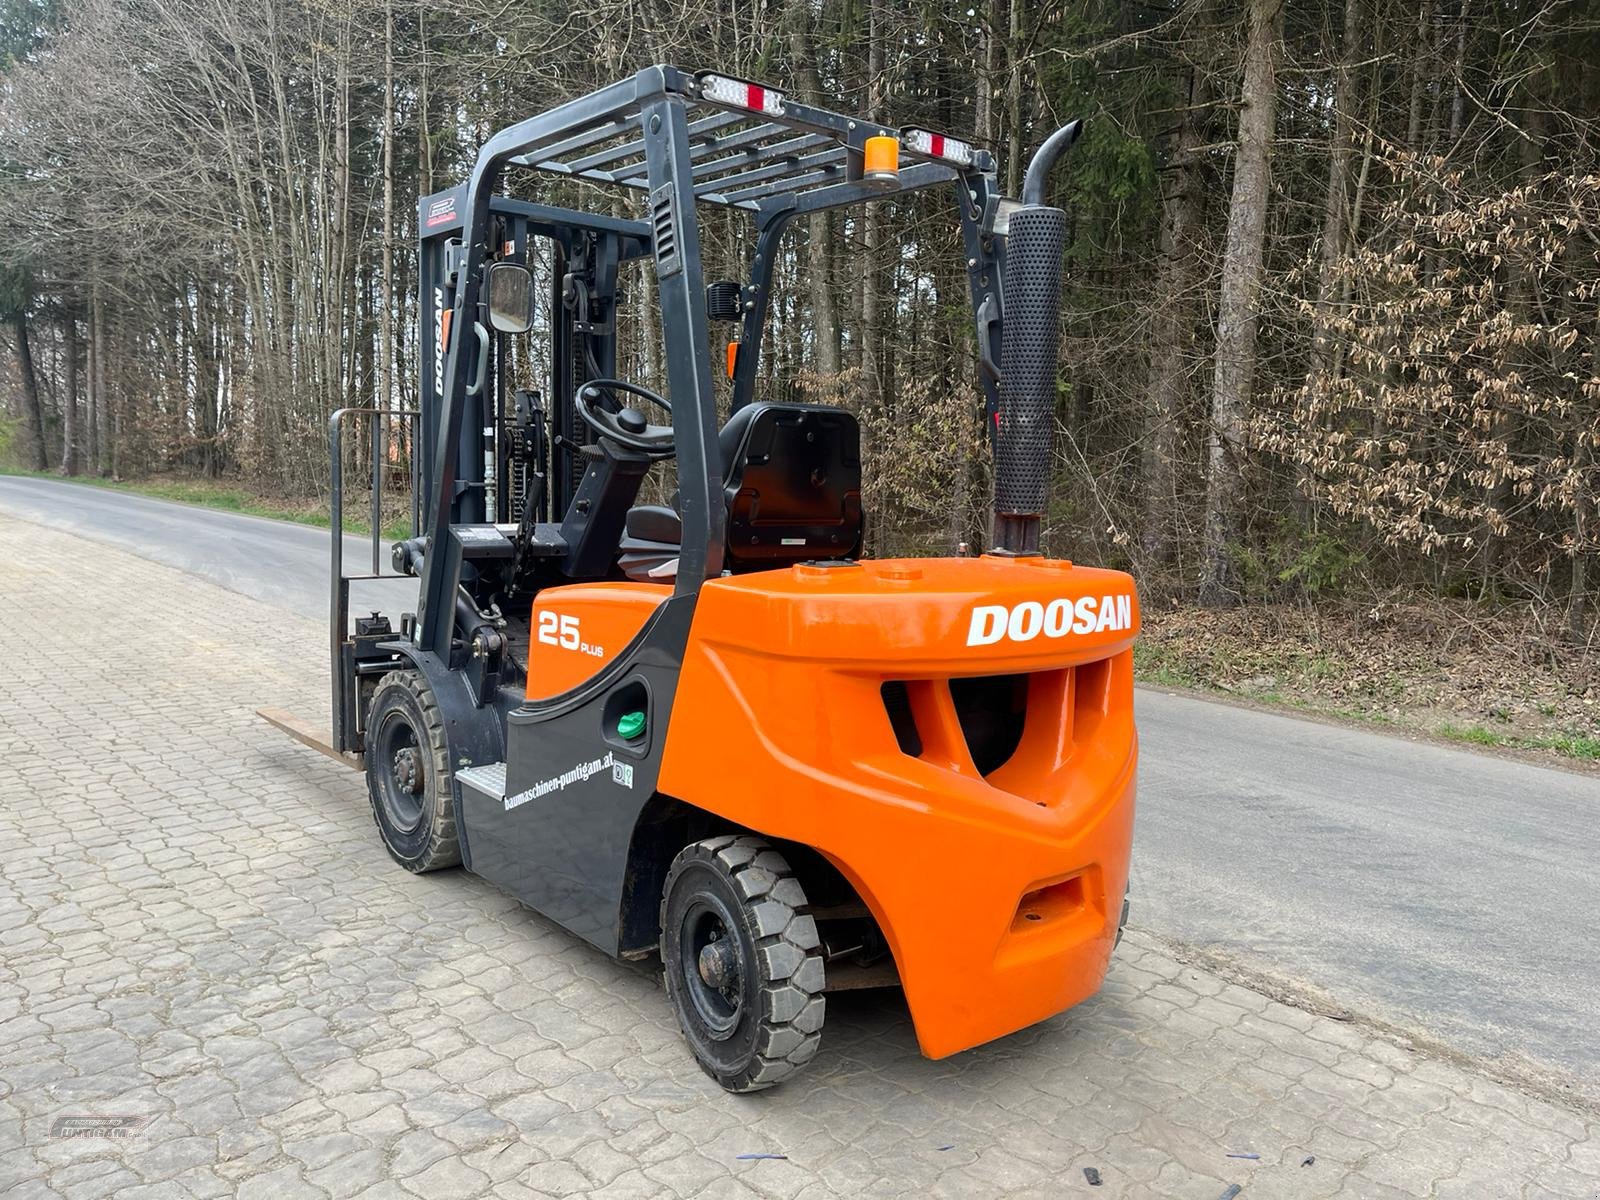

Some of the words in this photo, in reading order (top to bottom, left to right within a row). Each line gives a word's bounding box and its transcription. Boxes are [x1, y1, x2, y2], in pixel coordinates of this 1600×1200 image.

[435, 287, 443, 396] DOOSAN
[538, 610, 580, 651] 25
[580, 642, 604, 658] PLUS
[966, 595, 1131, 646] DOOSAN
[504, 751, 614, 811] baumaschinen-puntigam.at
